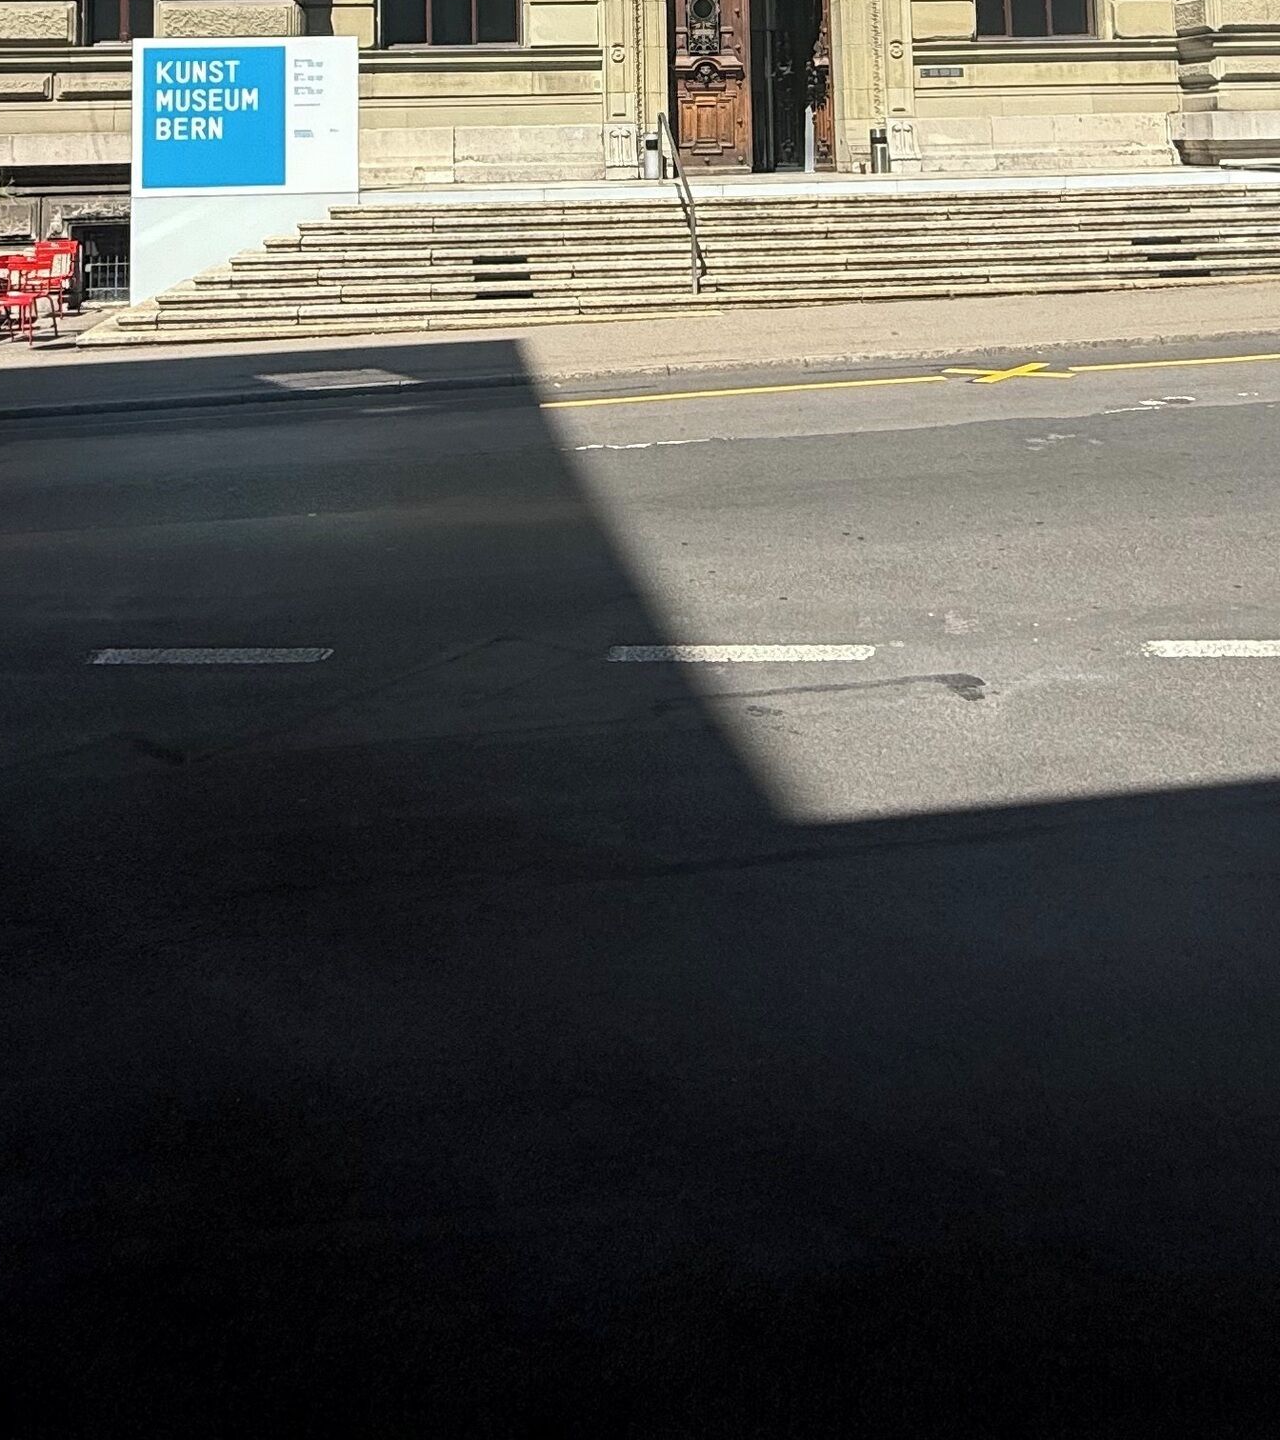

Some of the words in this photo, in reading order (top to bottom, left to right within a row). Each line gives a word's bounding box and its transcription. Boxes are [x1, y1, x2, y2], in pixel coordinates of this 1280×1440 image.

[156, 60, 240, 84] KUNST
[156, 88, 259, 112] MUSEUM
[155, 117, 223, 141] BERN
